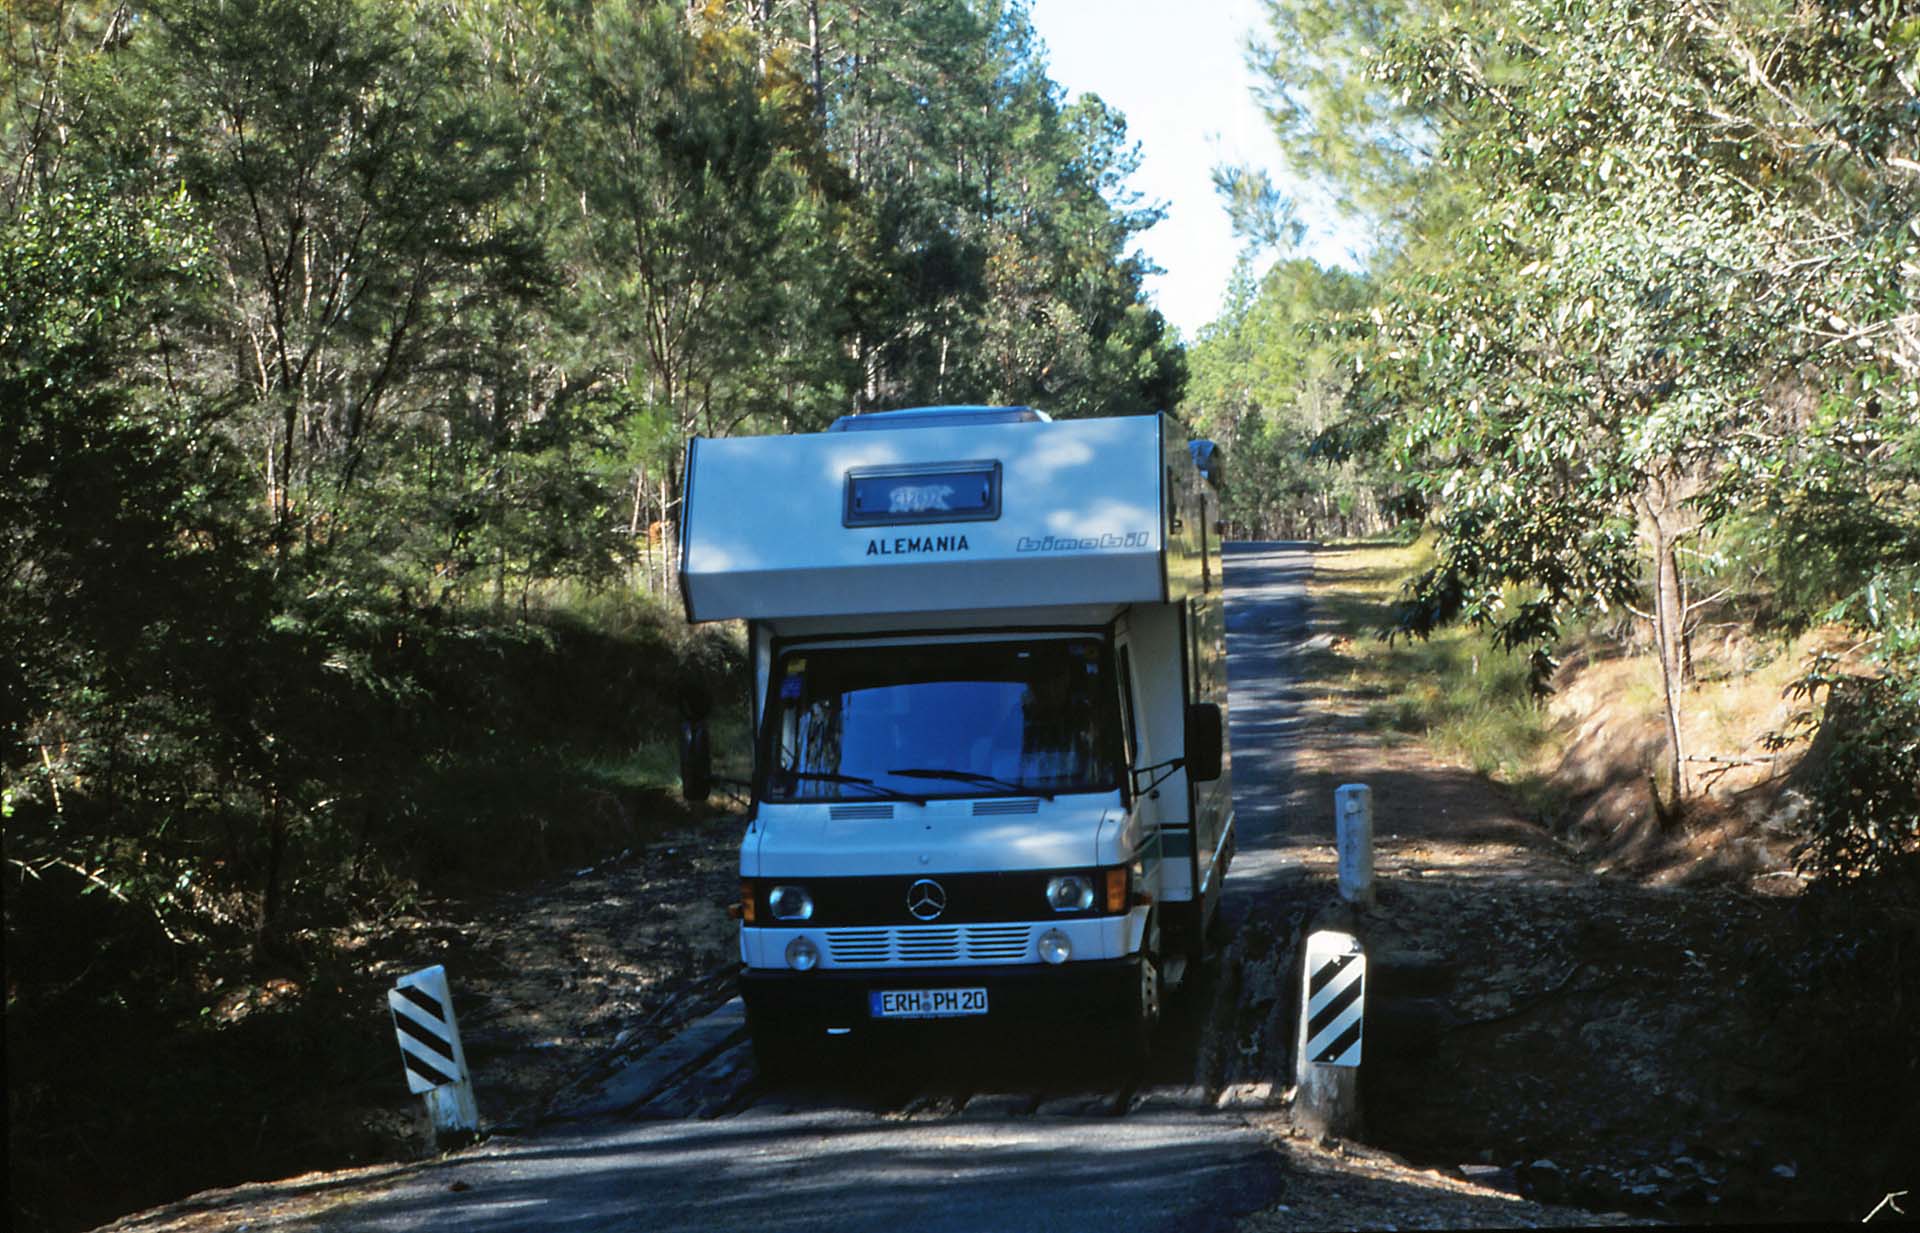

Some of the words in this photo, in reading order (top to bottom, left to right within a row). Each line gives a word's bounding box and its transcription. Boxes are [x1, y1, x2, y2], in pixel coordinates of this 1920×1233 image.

[866, 535, 969, 555] ALEMANIA
[1015, 531, 1150, 552] bimobil
[882, 994, 921, 1012] ERH
[933, 992, 958, 1011] PH
[962, 991, 985, 1010] 20
